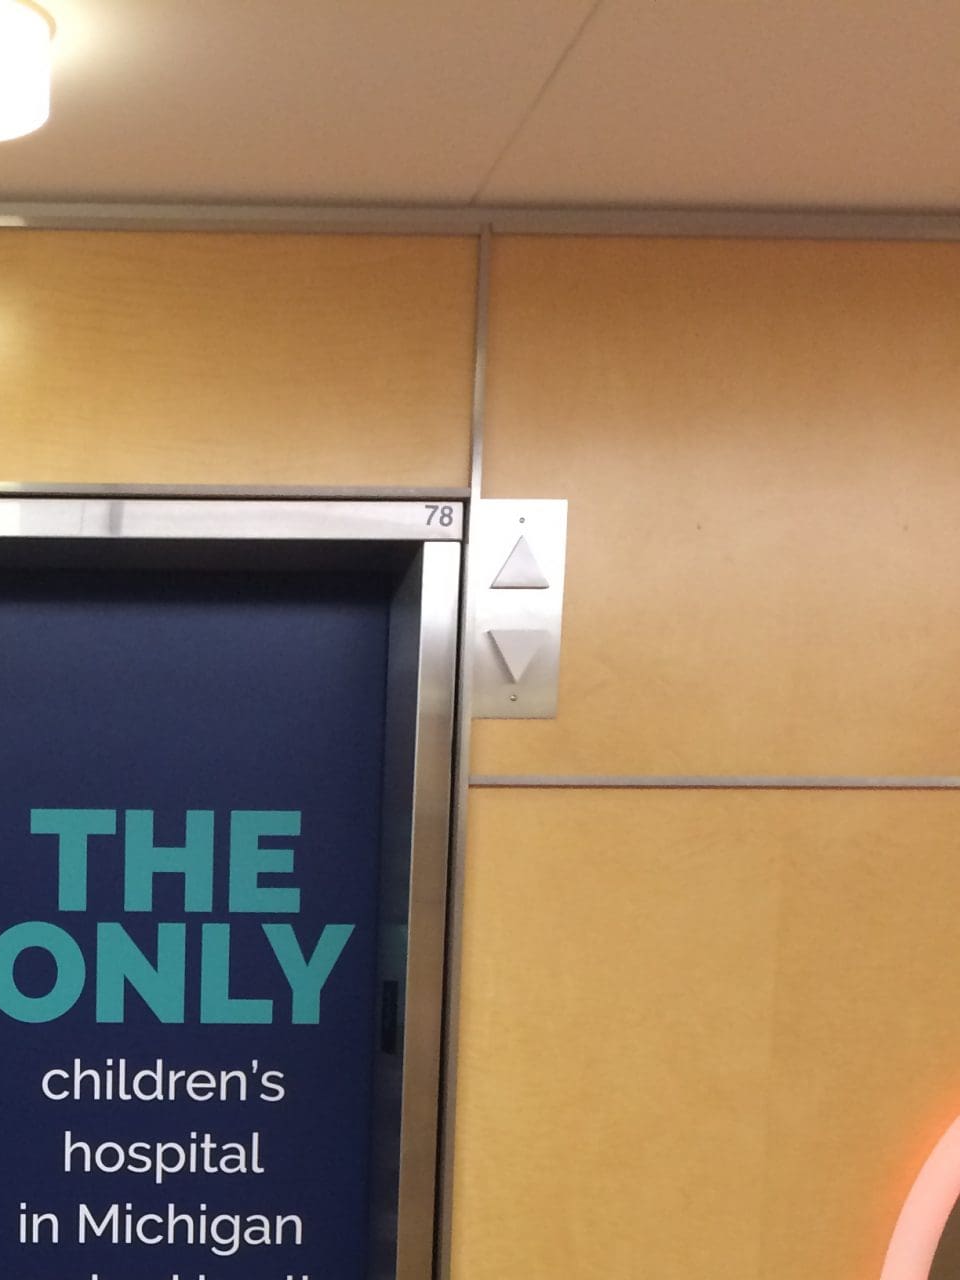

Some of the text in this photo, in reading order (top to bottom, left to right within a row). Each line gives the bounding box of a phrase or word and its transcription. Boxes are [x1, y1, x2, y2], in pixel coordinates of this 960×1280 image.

[424, 504, 454, 527] 78
[30, 808, 302, 913] THE
[40, 1058, 286, 1102] children's
[63, 1131, 265, 1184] hospital
[18, 1202, 304, 1257] in Michigan
